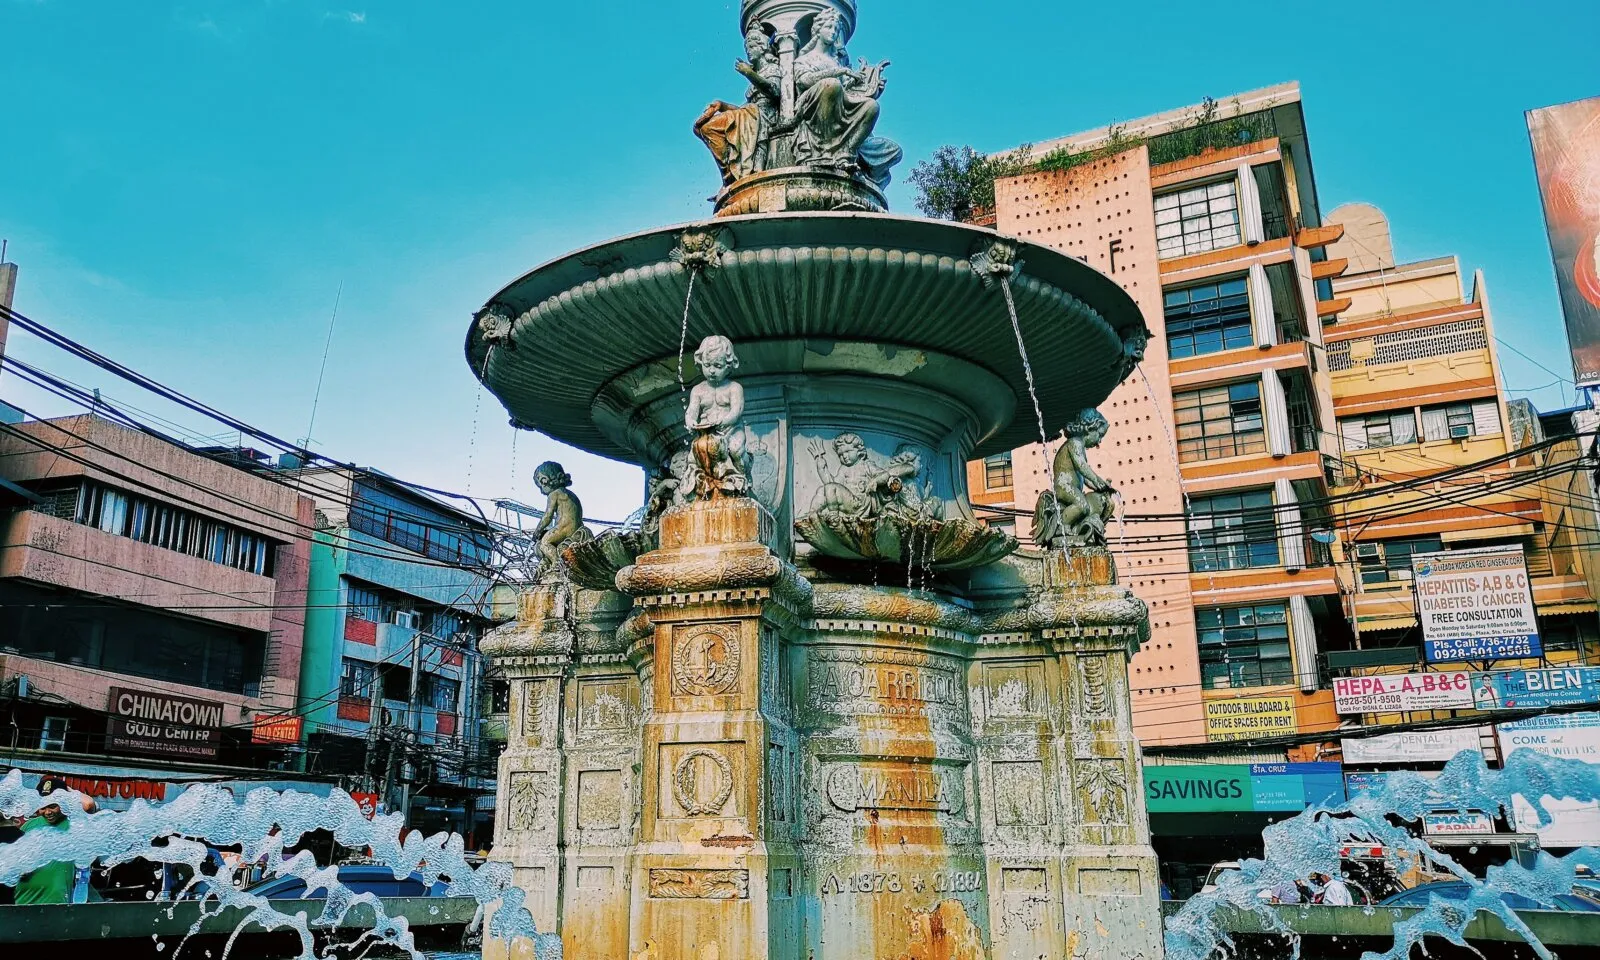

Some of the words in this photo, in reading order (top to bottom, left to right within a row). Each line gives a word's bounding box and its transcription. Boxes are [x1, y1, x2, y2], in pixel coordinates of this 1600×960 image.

[1580, 371, 1598, 379] ASC
[1455, 561, 1476, 569] KOREAN
[1476, 560, 1486, 568] RED
[1487, 557, 1509, 567] GINSENG
[1505, 574, 1515, 590] &
[1517, 573, 1526, 589] C
[1423, 596, 1474, 610] DIABETES
[1482, 592, 1526, 607] CANCER
[1431, 612, 1454, 624] FREE
[1456, 608, 1522, 622] CONSULTATION
[1433, 641, 1452, 649] Pls.
[1455, 640, 1478, 648] Call:
[1481, 636, 1529, 646] 736-7732
[1337, 678, 1385, 696] HEPA
[1525, 669, 1582, 691] BIEN
[1504, 683, 1525, 692] THE
[1339, 695, 1401, 706] 0928-501-9508
[118, 693, 222, 728] CHINATOWN
[1208, 703, 1242, 715] OUTDOOR
[1244, 701, 1283, 713] BILLBOARD
[1284, 701, 1290, 711] &
[1210, 718, 1232, 729] OFFICE
[1234, 716, 1259, 728] SPACES
[1260, 716, 1273, 727] FOR
[1274, 716, 1292, 727] RENT
[1539, 717, 1560, 725] GEMS
[126, 720, 160, 738] GOLD
[165, 724, 210, 741] CENTER
[272, 726, 296, 740] CENTER
[1209, 732, 1223, 741] CALL
[1402, 735, 1440, 744] DENTAL
[1512, 736, 1547, 745] COME
[1268, 765, 1287, 773] CRUZ
[855, 774, 951, 804] MANILA
[1149, 779, 1242, 799] SAVINGS
[850, 871, 902, 893] 1878
